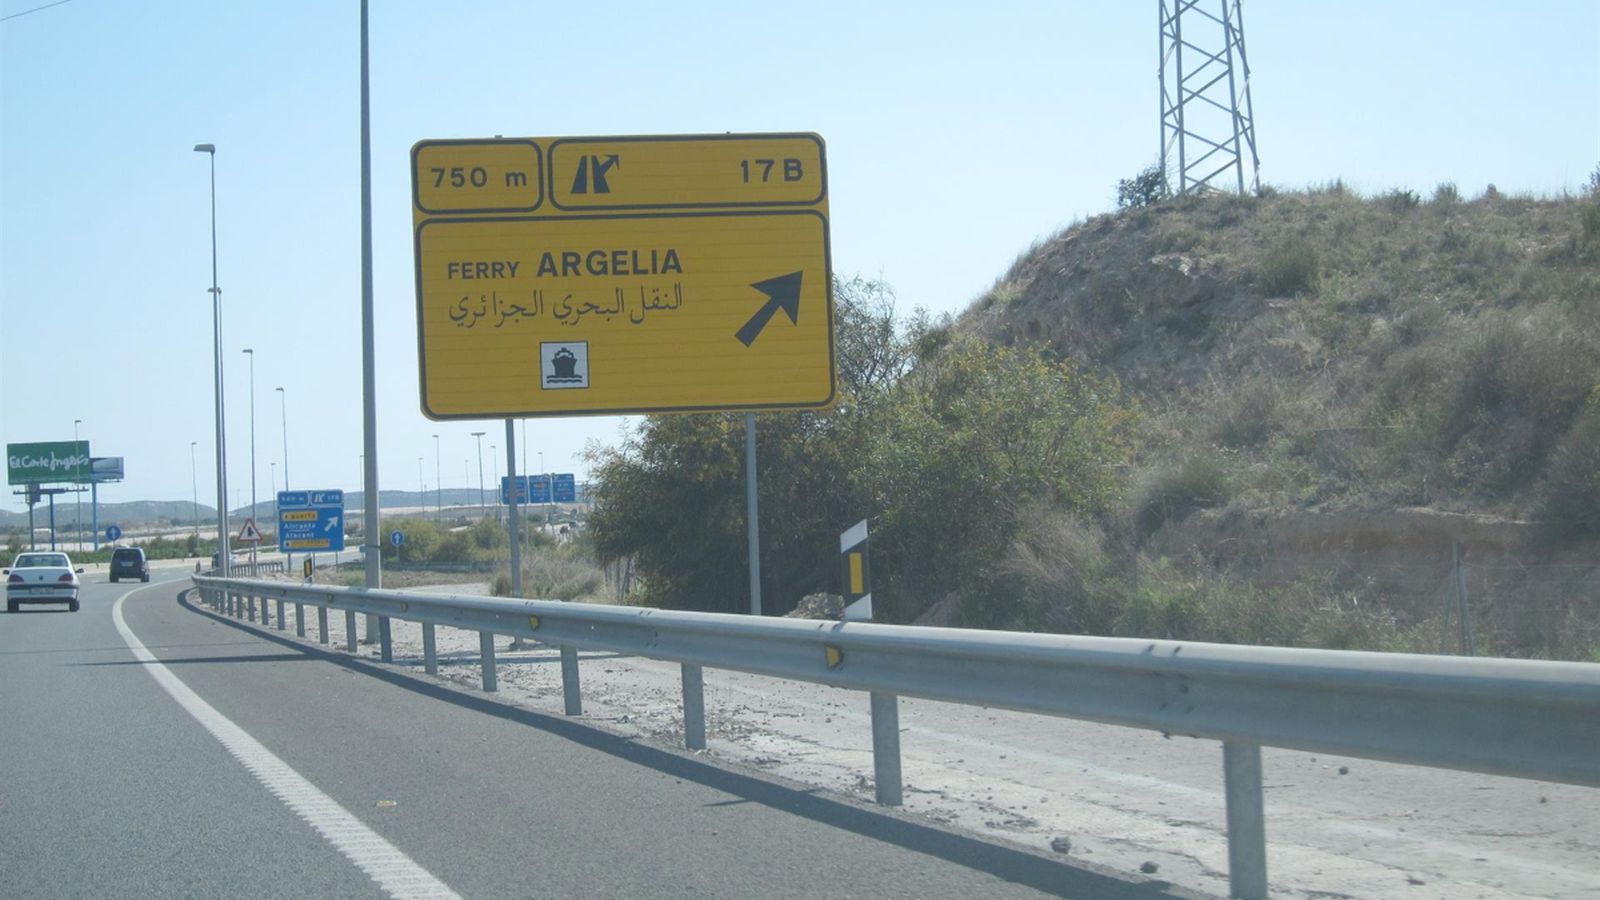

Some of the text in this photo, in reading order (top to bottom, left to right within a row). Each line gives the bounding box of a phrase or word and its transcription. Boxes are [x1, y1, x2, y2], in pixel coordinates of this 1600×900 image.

[430, 166, 528, 188] 750 m
[448, 249, 683, 280] FERRY ARGELIA
[449, 282, 682, 328] النقل البحري الجزائري
